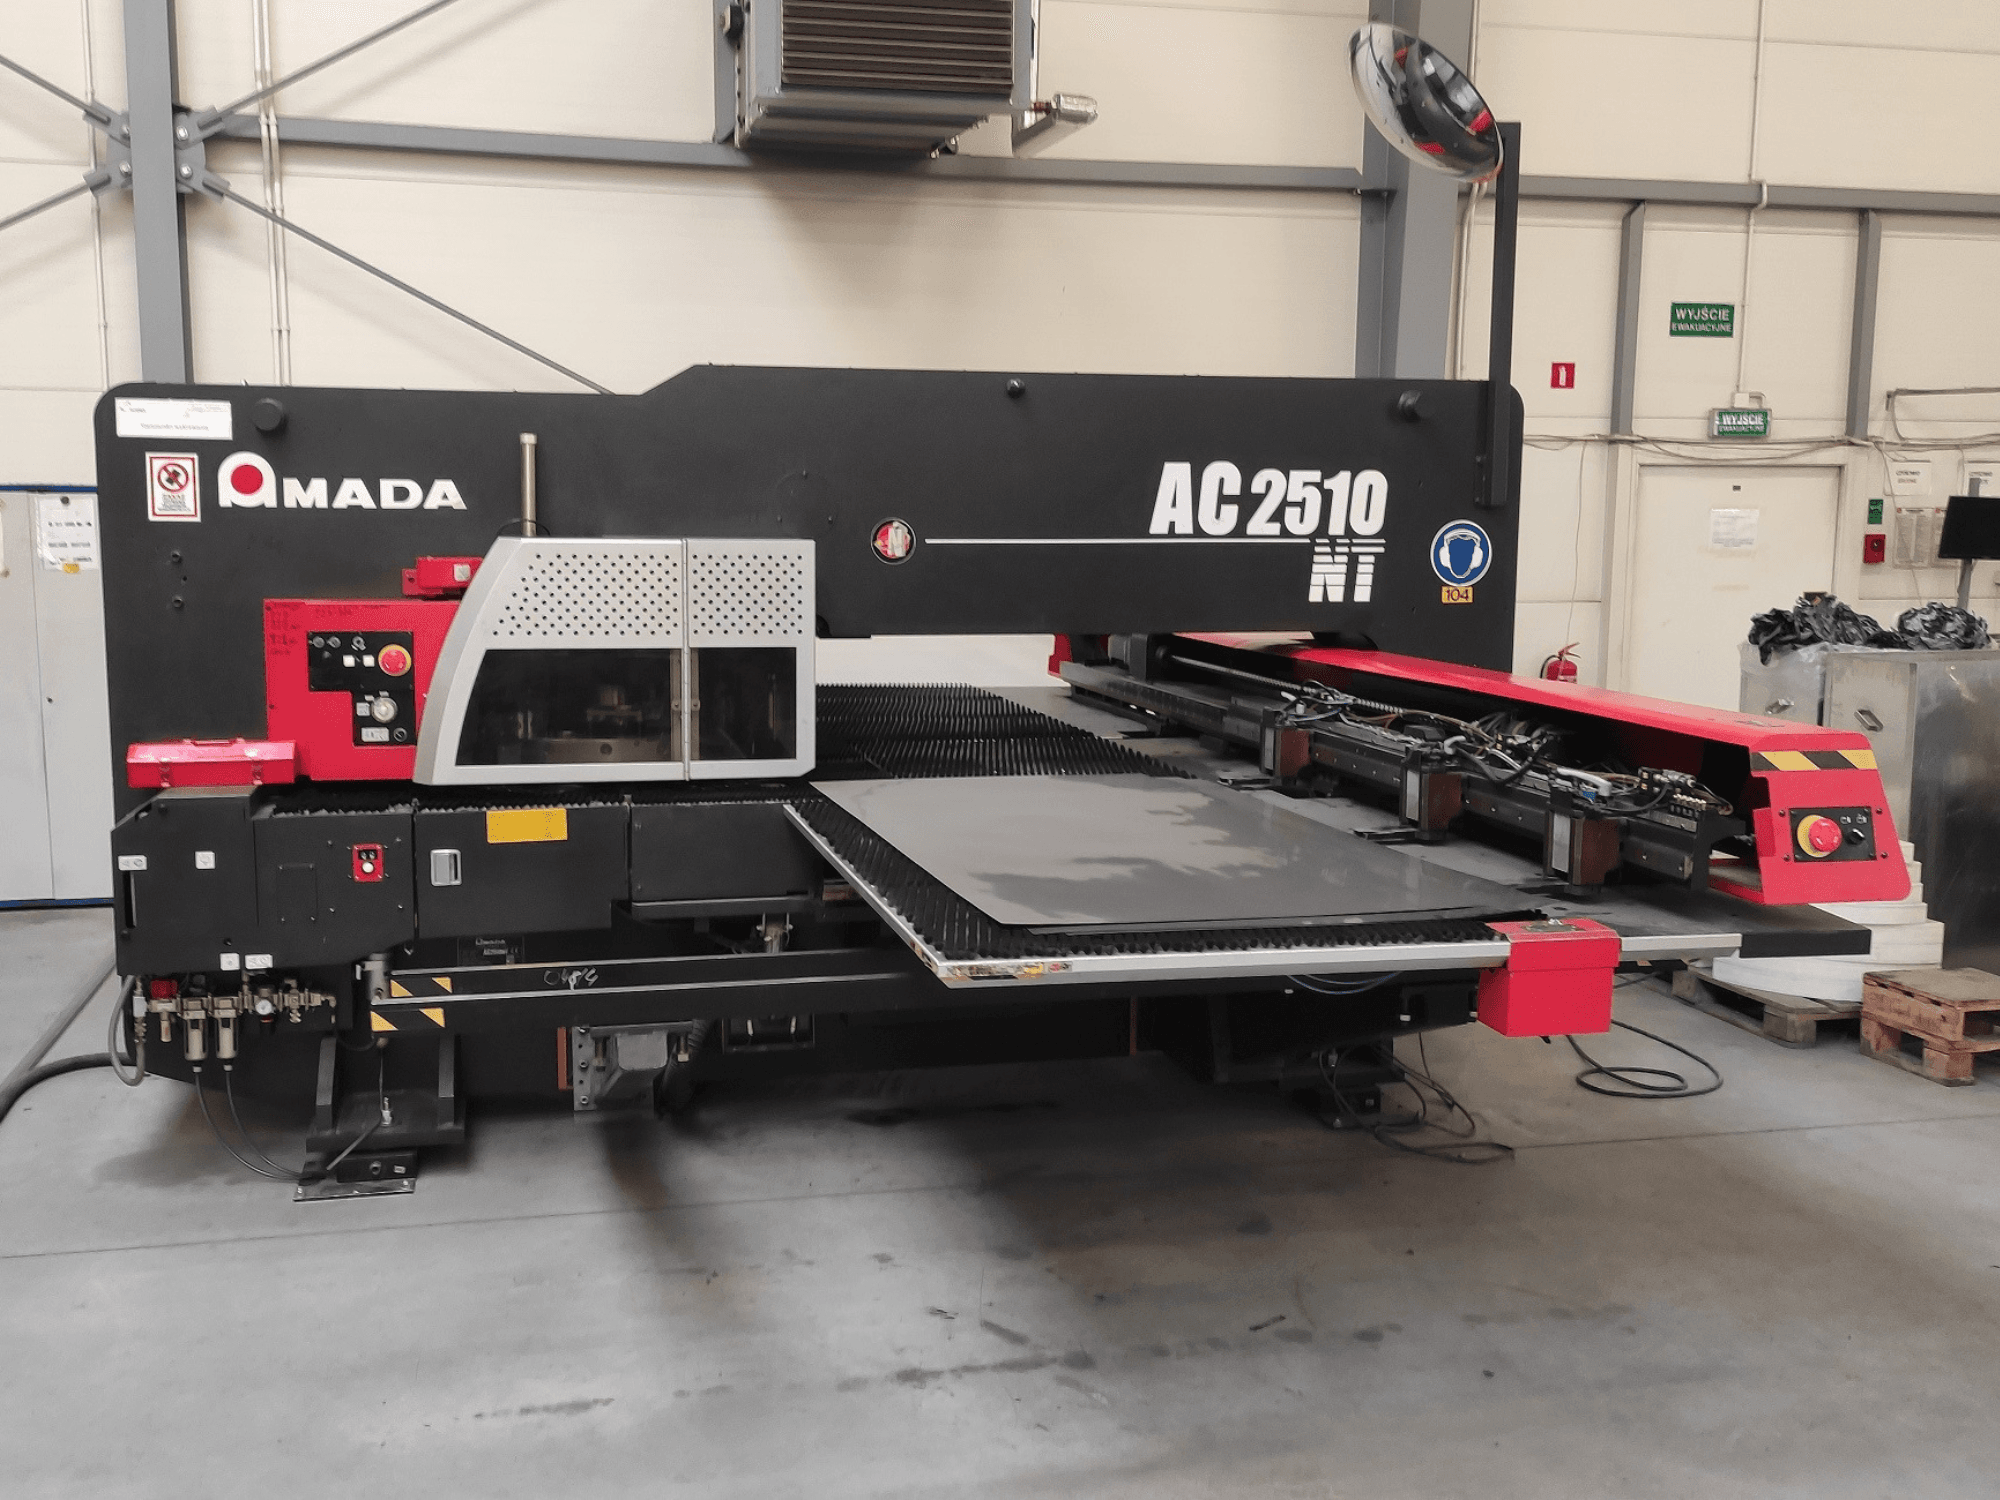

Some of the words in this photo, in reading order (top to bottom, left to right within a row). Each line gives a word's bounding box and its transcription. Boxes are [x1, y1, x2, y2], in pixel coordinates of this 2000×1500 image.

[1675, 306, 1729, 321] WYJŚCIE
[218, 451, 467, 509] AMADA
[1445, 588, 1469, 602] 104
